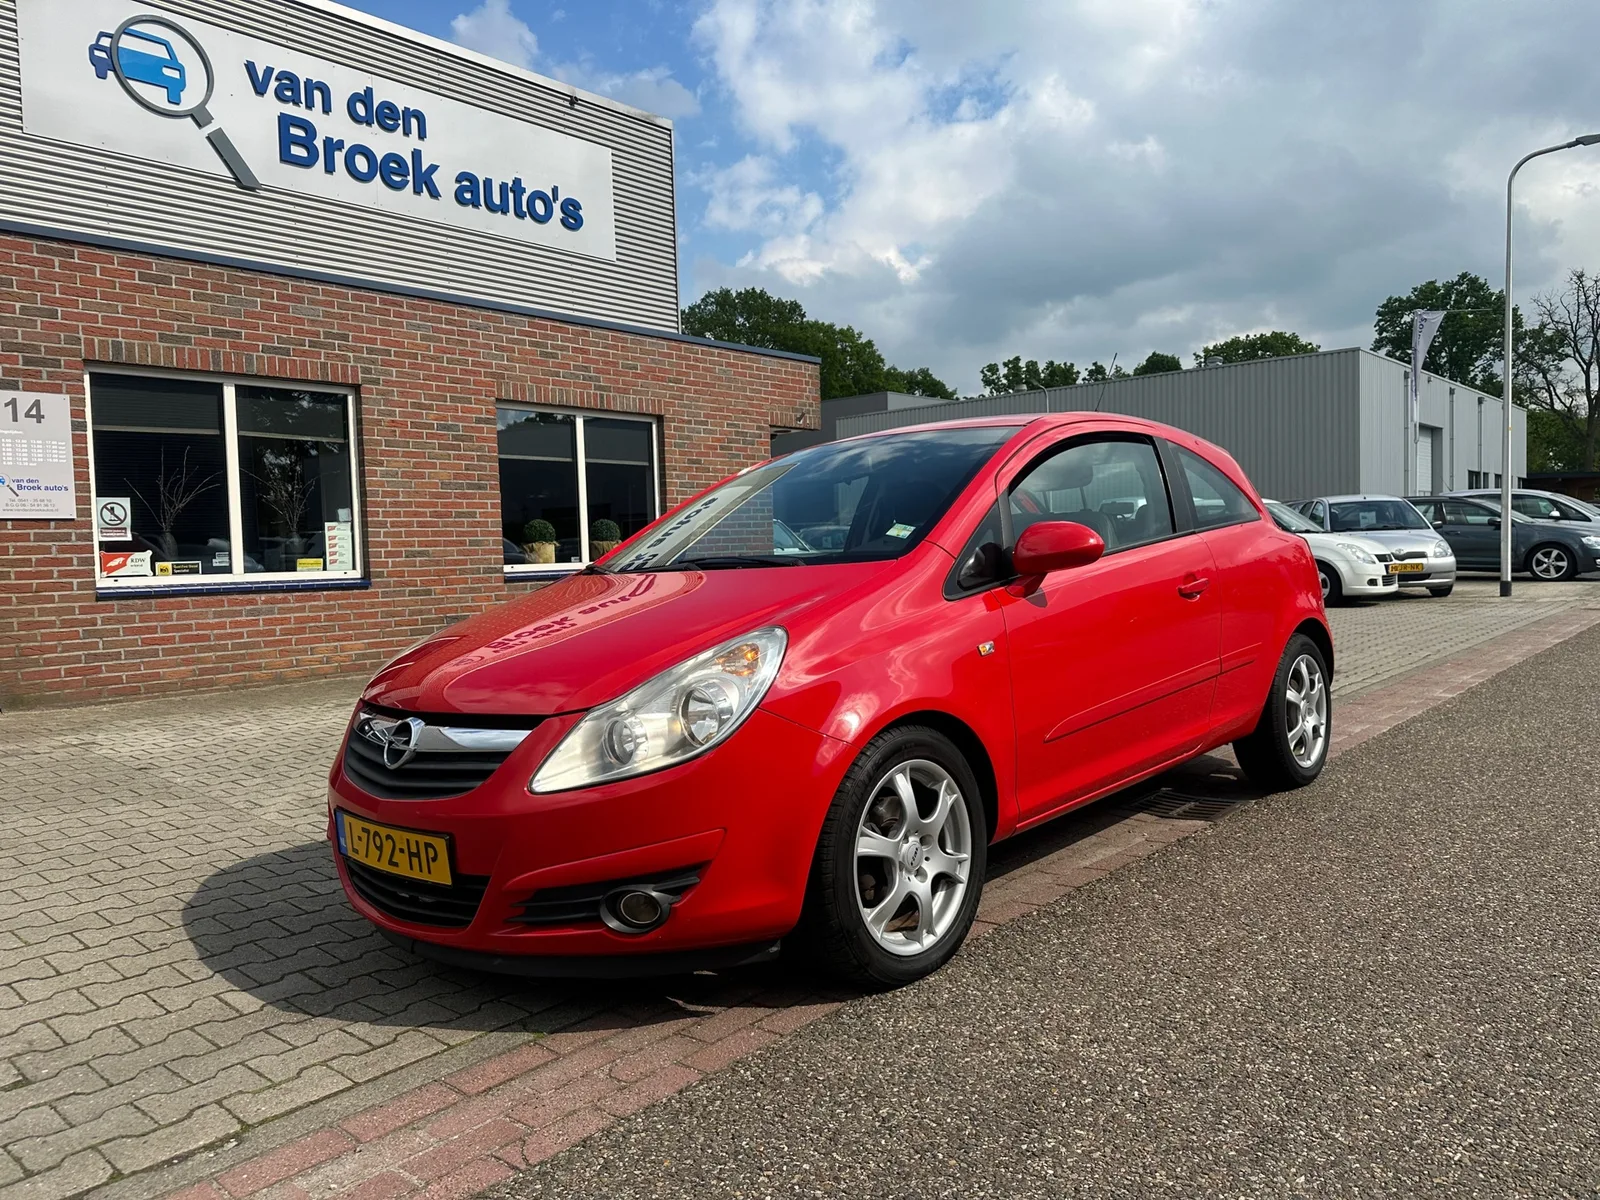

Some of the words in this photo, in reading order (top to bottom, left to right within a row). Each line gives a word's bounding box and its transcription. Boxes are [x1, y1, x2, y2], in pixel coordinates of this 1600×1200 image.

[244, 59, 332, 116] van
[347, 86, 427, 141] den
[278, 112, 442, 201] Broek
[454, 171, 584, 231] auto's
[4, 397, 45, 424] 14
[17, 483, 42, 491] Broek
[348, 821, 439, 875] L-792-HP
